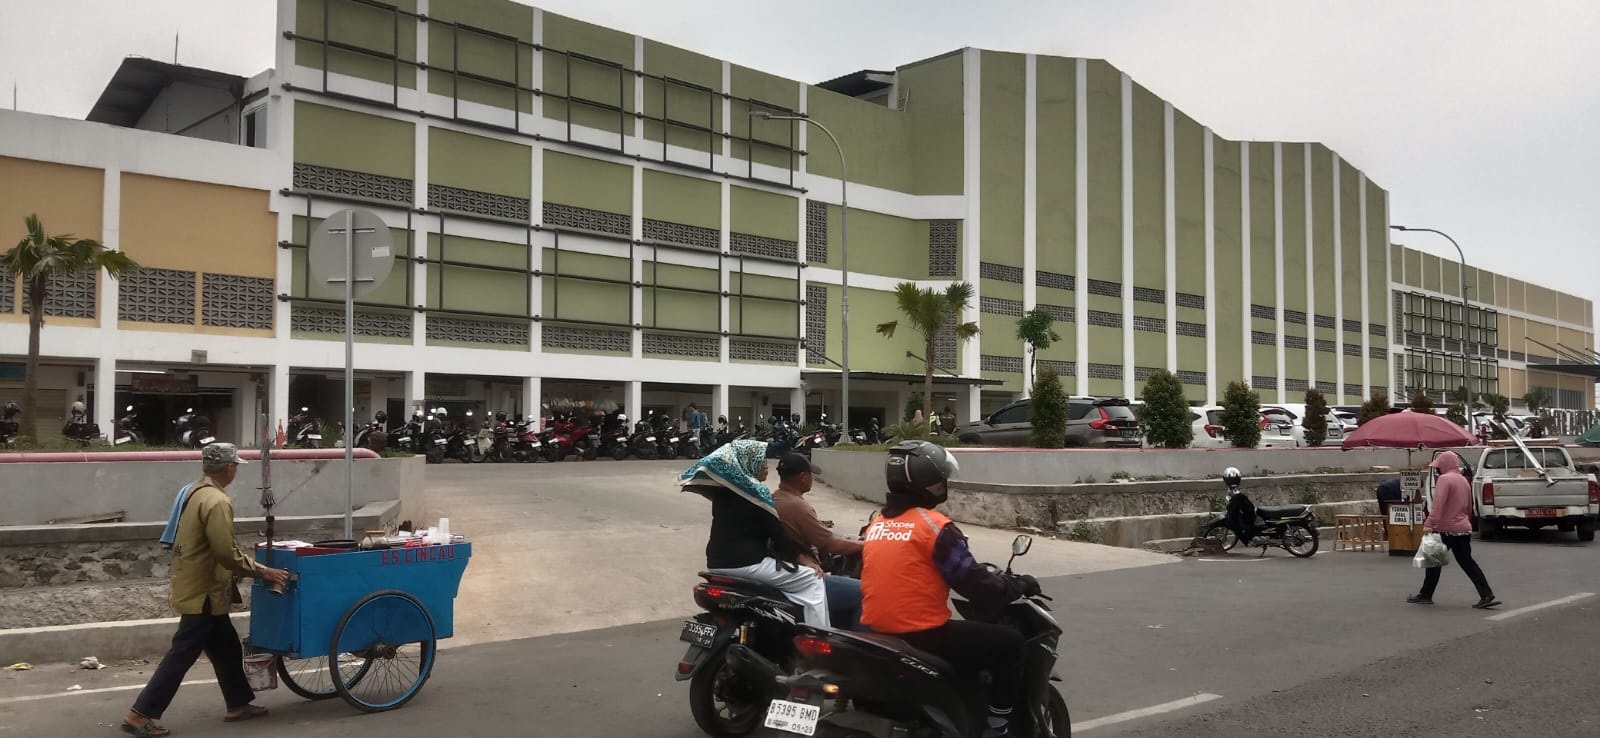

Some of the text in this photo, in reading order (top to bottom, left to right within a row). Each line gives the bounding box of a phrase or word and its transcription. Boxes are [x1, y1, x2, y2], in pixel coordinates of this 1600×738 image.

[885, 520, 915, 529] Shopee
[881, 529, 913, 541] Food
[382, 545, 455, 565] ES CINCAU
[770, 702, 818, 721] B 5395 BMD
